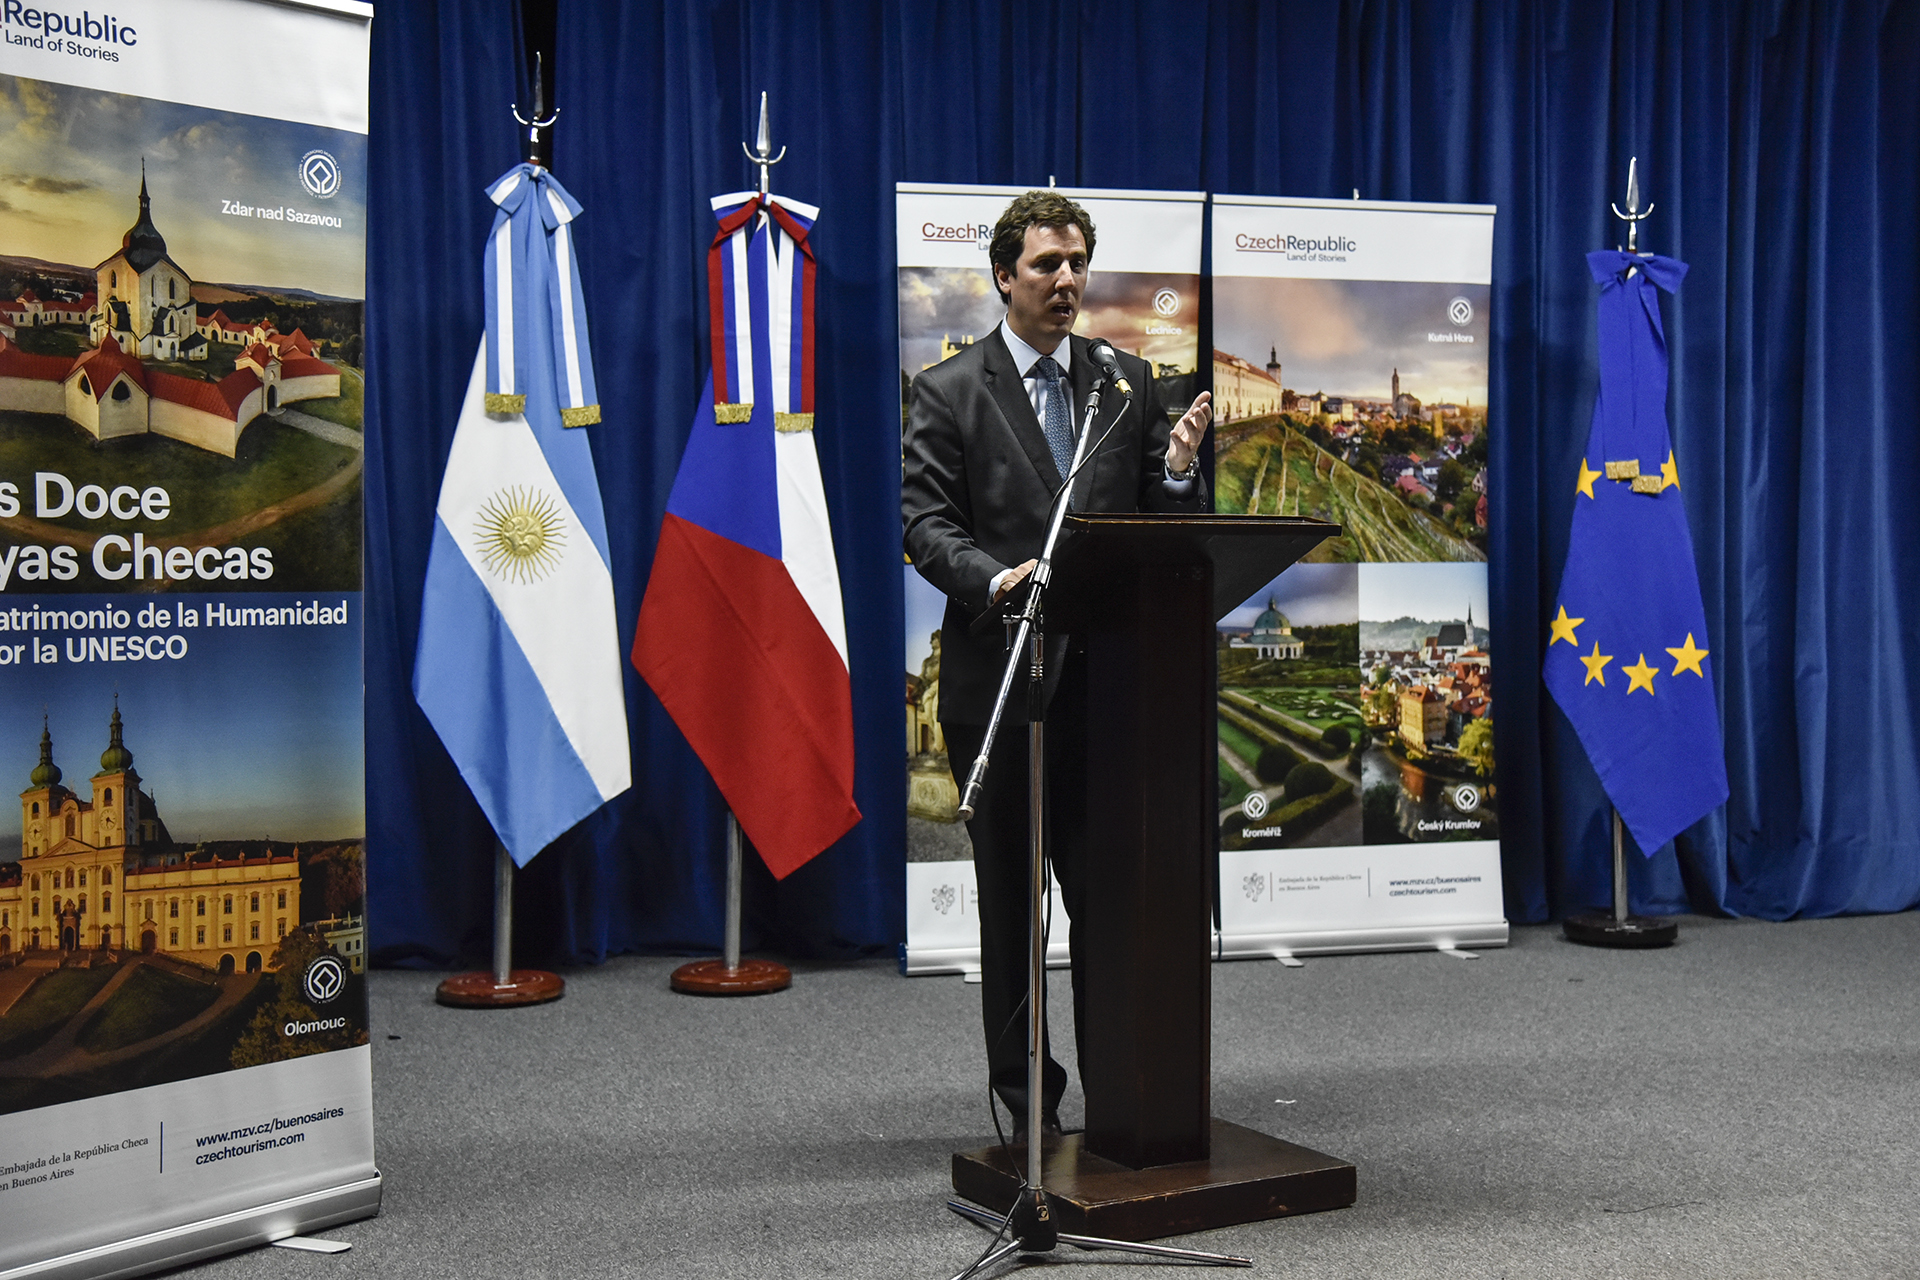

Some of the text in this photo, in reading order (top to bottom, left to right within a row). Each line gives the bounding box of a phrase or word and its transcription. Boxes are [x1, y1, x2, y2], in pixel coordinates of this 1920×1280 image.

[0, 0, 137, 46] Republic
[5, 29, 119, 62] Land of Stories
[221, 200, 342, 228] Zdar nad Sazavou
[922, 222, 995, 239] CzechRe
[1235, 233, 1356, 253] CzechRepublic
[978, 242, 990, 251] La
[1287, 253, 1347, 262] Land of Stories
[1145, 325, 1182, 335] Lednice
[1454, 332, 1474, 343] Hora
[0, 472, 171, 521] s Doce
[0, 533, 274, 591] yas Checas
[0, 600, 347, 631] atrimonio de la Humanidad
[0, 635, 188, 665] or la UNESCO
[1417, 819, 1481, 832] Český Krumlov
[284, 1016, 346, 1037] Olomouc
[196, 1105, 344, 1149] www.mzv.cz/buenosaires
[0, 1137, 149, 1176] Embajada de la República Checa
[195, 1131, 305, 1166] czechtourism.com
[12, 1173, 48, 1189] Buenos
[50, 1168, 75, 1181] Aires
